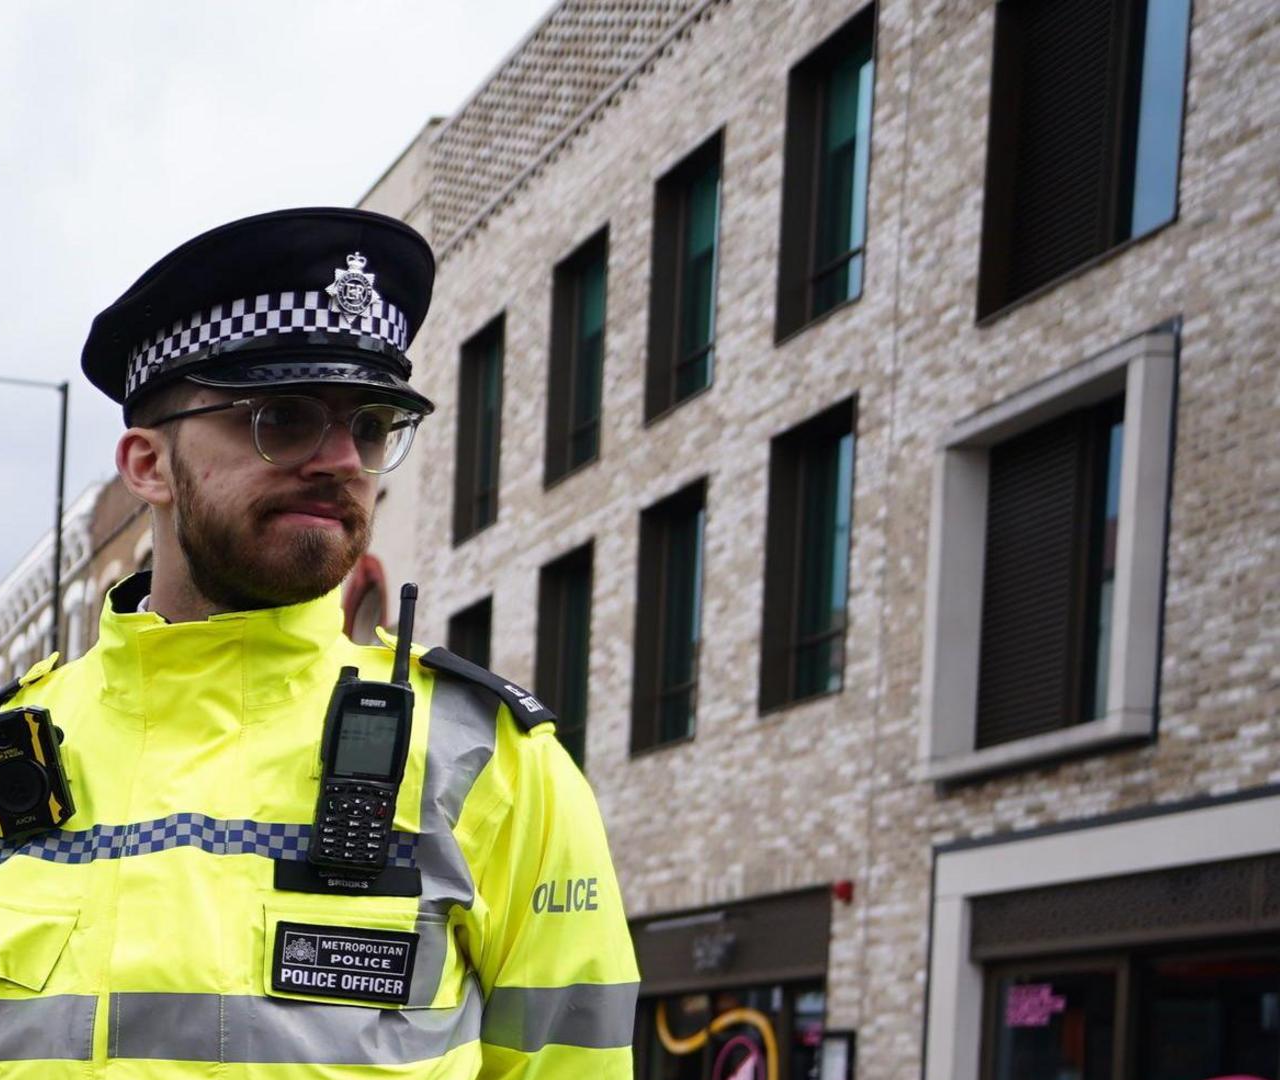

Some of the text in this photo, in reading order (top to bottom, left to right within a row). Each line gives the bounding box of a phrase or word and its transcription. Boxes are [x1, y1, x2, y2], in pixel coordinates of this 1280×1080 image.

[532, 877, 599, 914] OLICE
[321, 940, 404, 957] METROPOLITAN
[330, 954, 392, 970] POLICE
[280, 967, 404, 996] POLICE OFFICER
